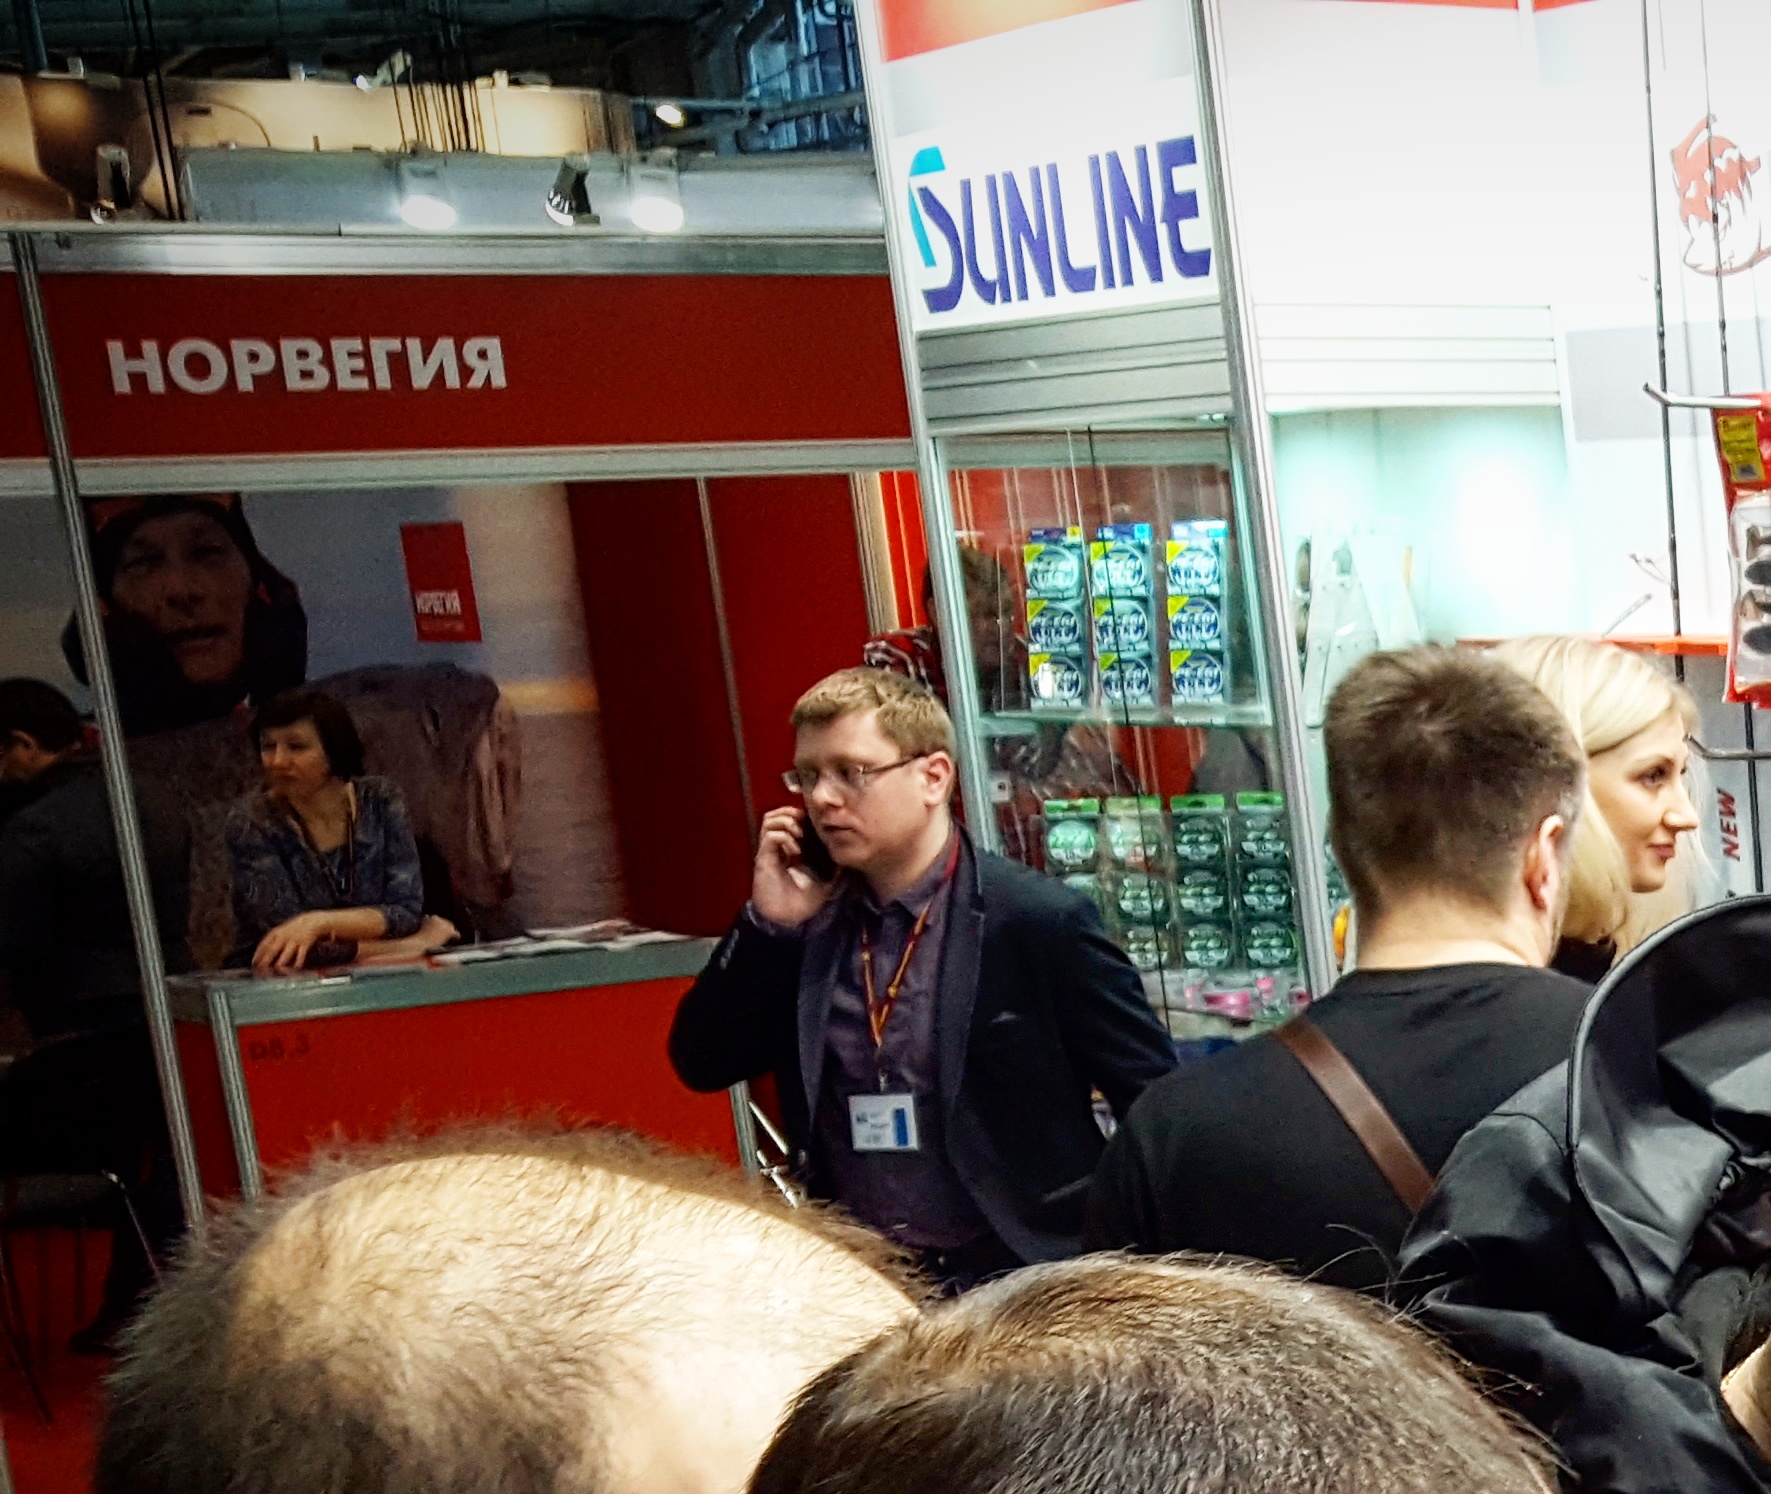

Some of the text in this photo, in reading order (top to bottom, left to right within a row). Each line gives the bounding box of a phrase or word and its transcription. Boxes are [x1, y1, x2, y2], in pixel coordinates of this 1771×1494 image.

[908, 136, 1213, 315] SUNLINE
[107, 336, 507, 396] НОРВЕГИЯ
[1716, 788, 1742, 862] NEW
